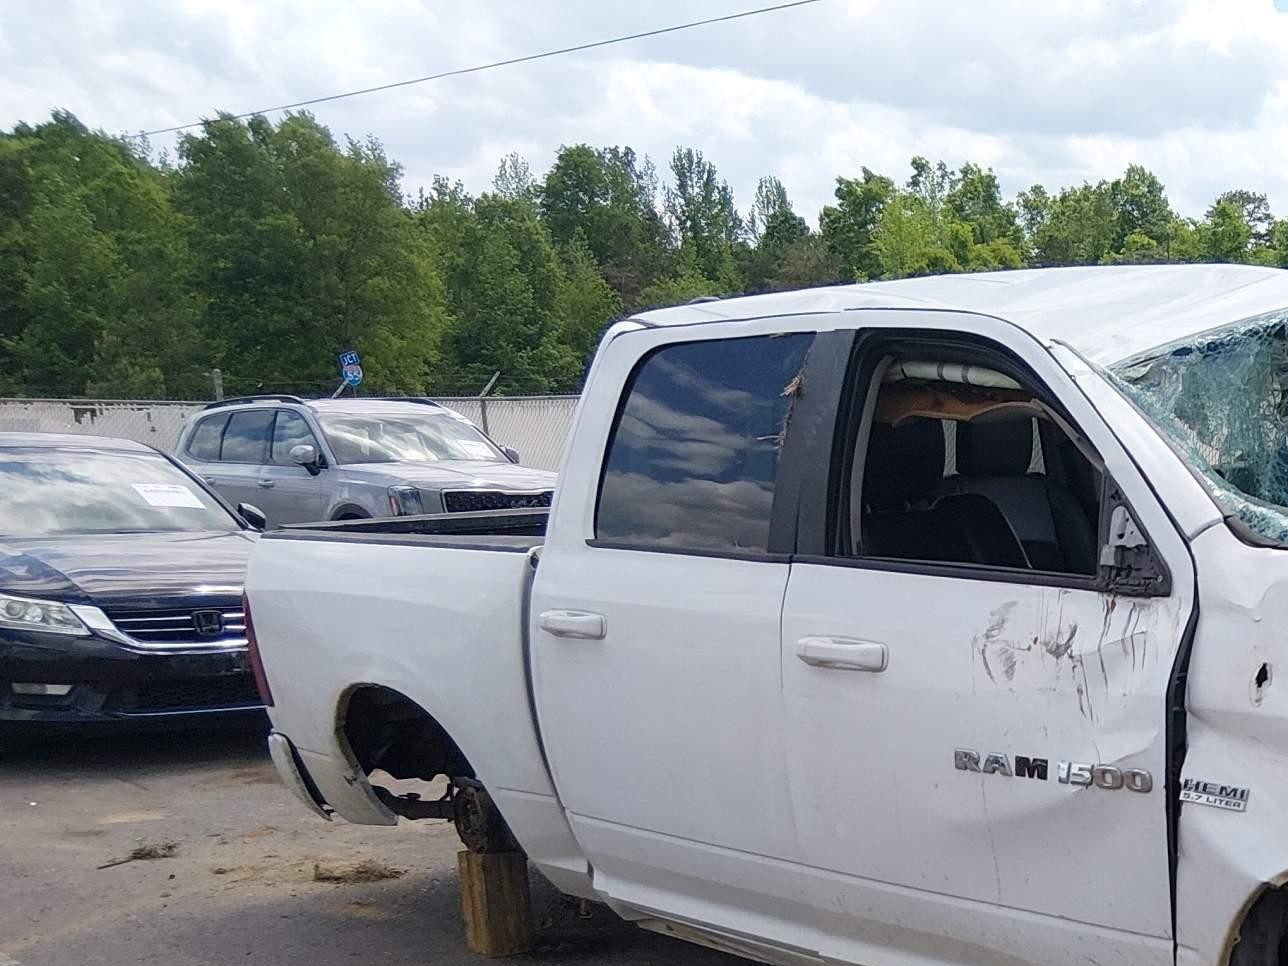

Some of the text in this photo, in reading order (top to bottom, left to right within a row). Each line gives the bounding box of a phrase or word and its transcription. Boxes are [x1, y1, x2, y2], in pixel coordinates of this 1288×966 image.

[343, 353, 357, 366] JCT
[954, 747, 1153, 793] RAM 1500
[1183, 778, 1250, 801] HEMI
[1183, 792, 1242, 809] 5.7 LITER
